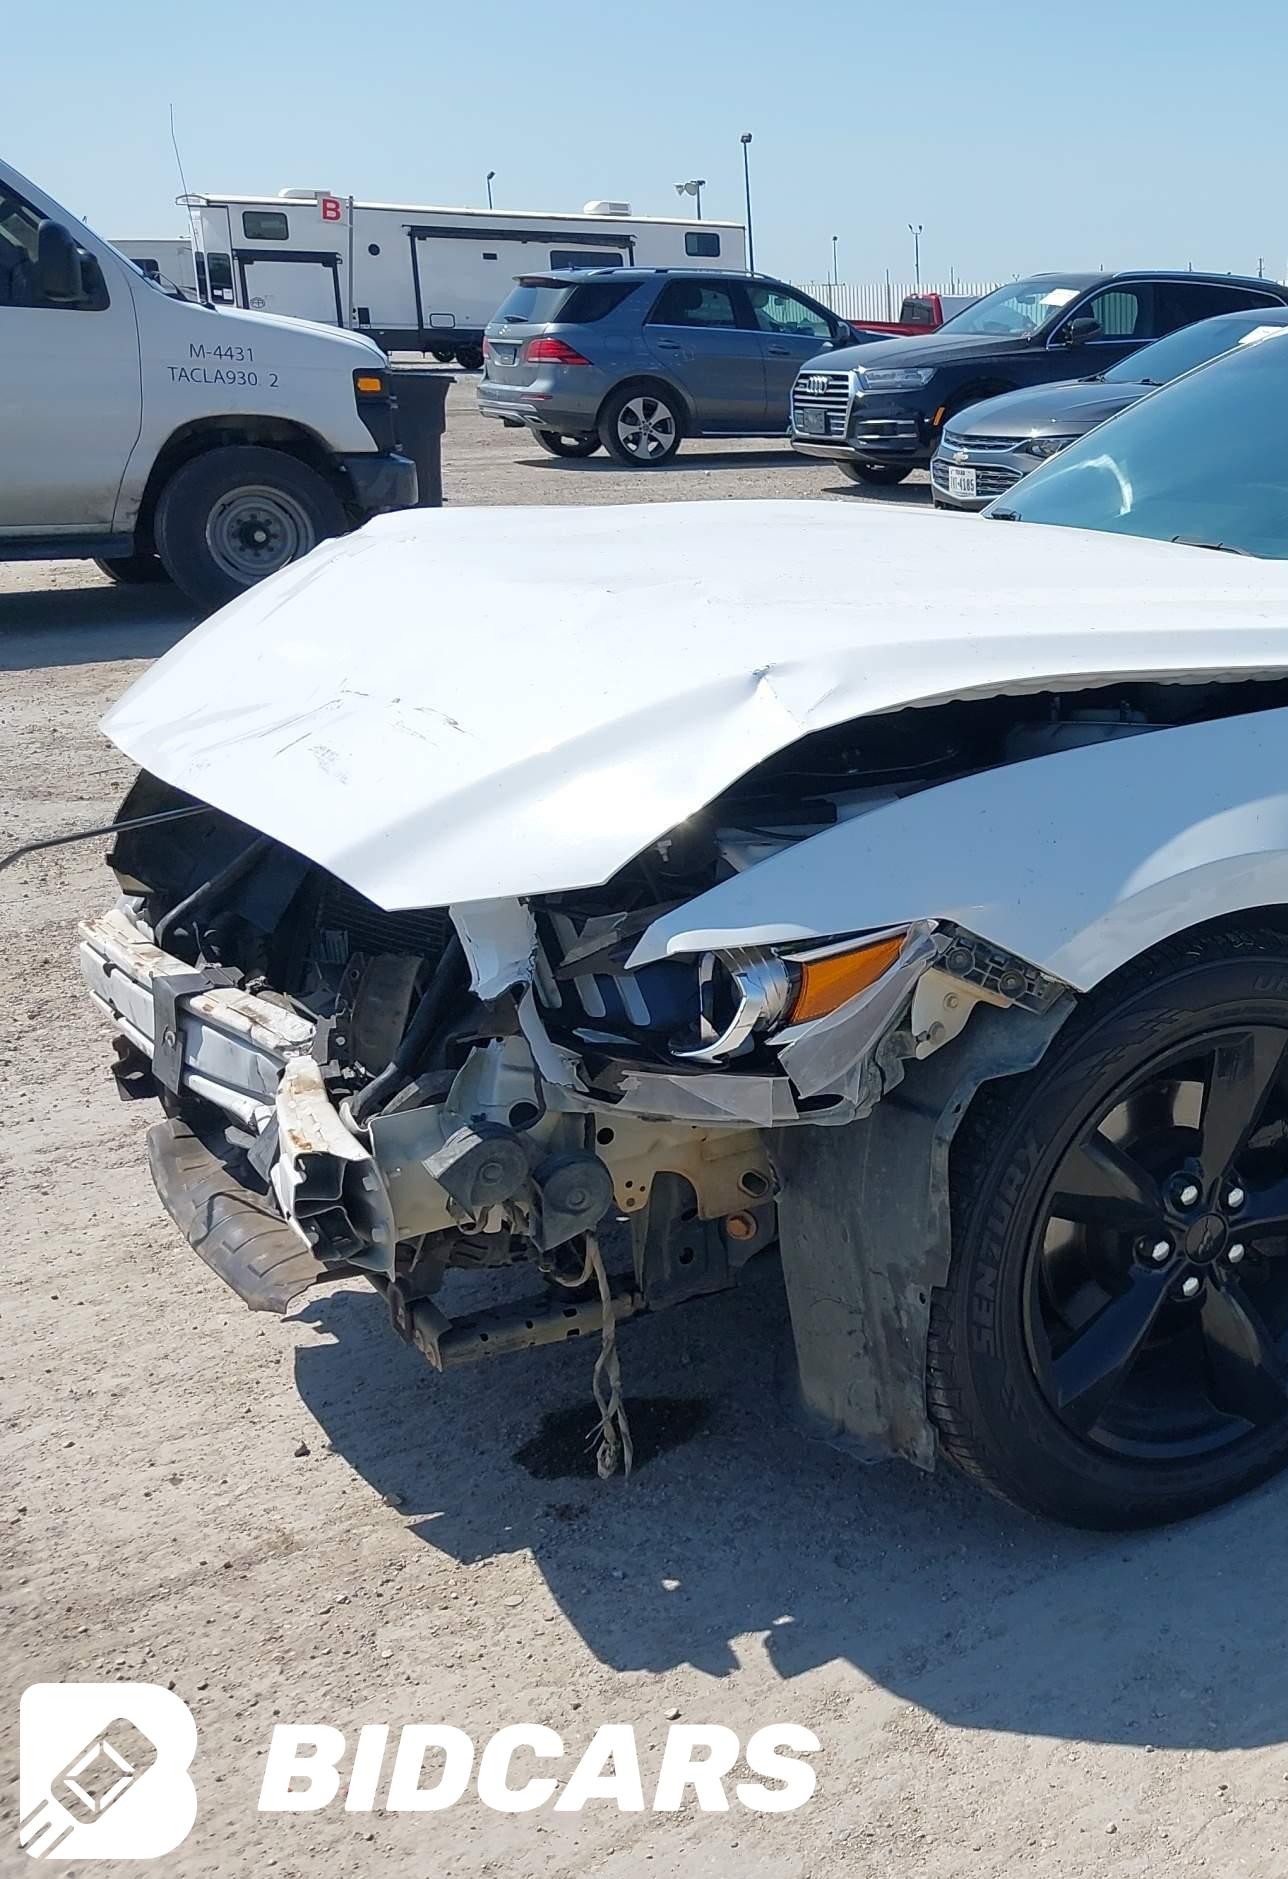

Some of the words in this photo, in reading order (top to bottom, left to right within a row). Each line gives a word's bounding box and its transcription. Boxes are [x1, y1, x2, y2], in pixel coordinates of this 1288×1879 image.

[321, 198, 342, 222] B
[189, 343, 254, 362] M-4431
[970, 1127, 1047, 1358] SENTURY
